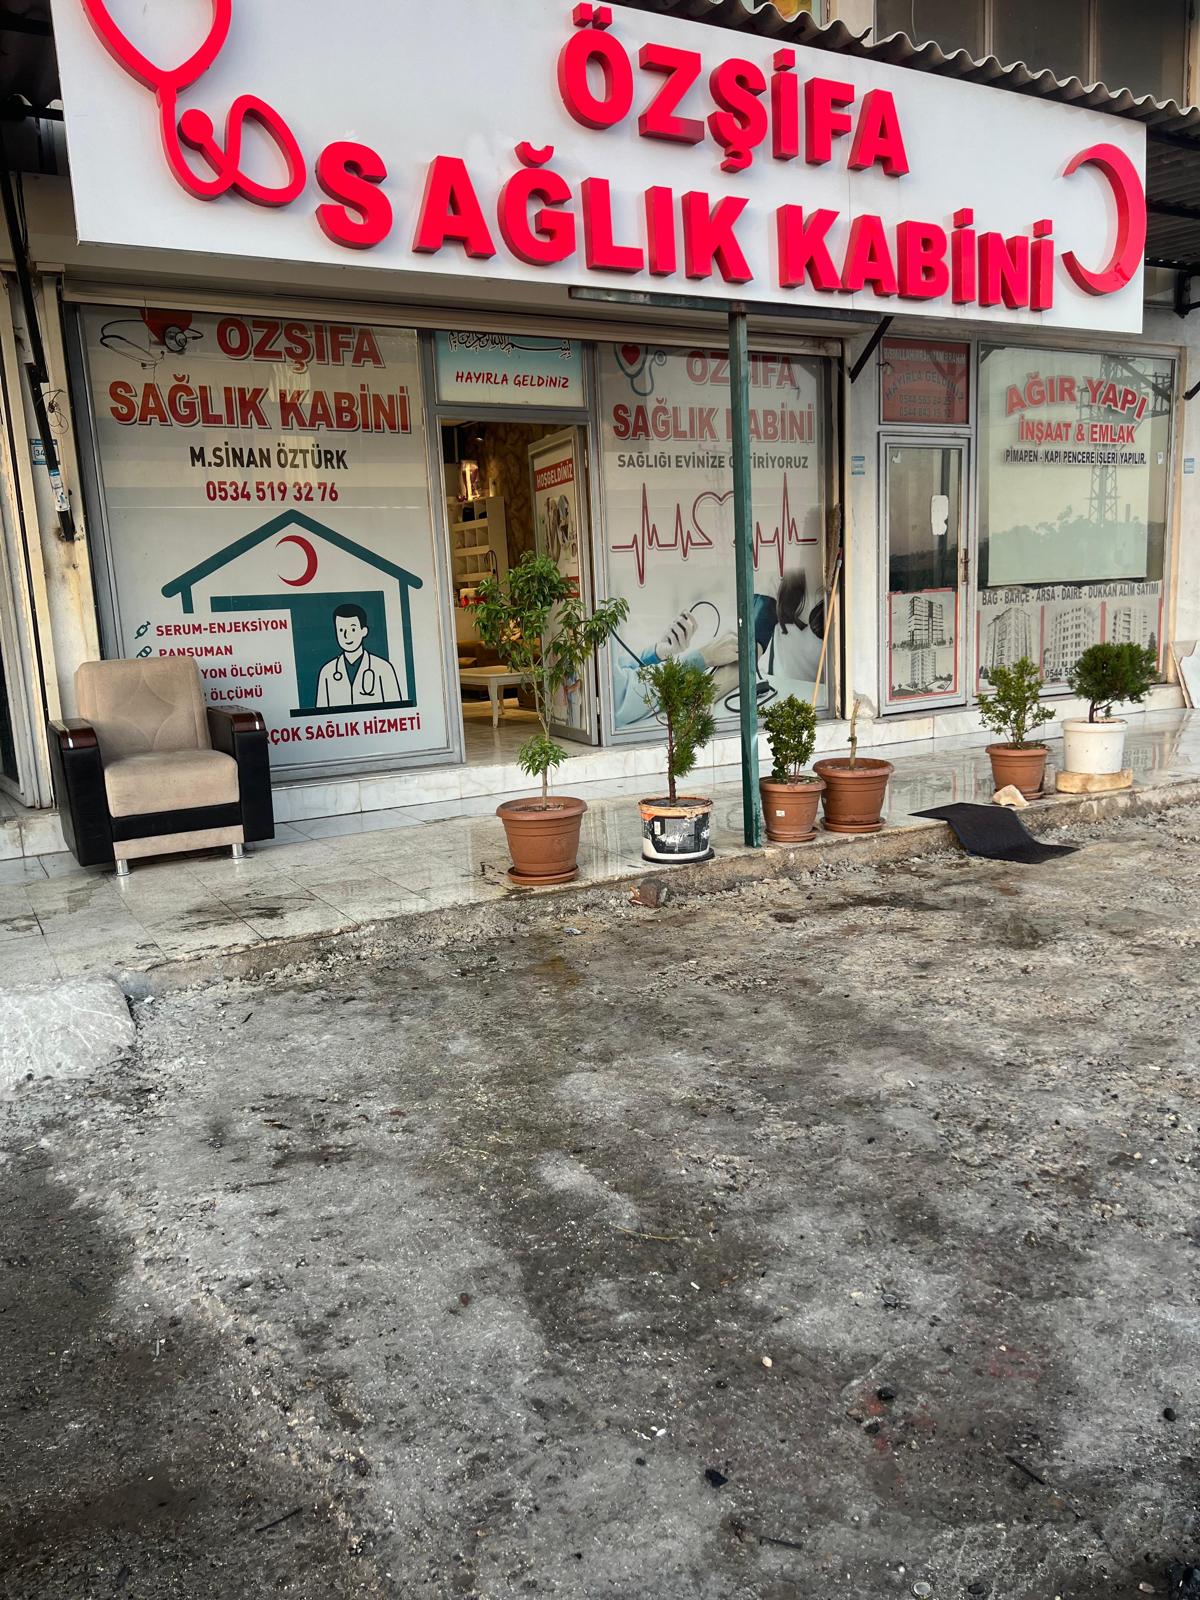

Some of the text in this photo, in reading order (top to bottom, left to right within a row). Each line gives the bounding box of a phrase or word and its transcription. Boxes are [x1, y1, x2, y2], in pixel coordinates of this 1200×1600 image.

[557, 3, 909, 177] ÖZŞİFA
[315, 141, 1054, 312] SAĞLIK KABİNİ
[455, 370, 569, 389] HAYIRLA GELDİNİZ
[108, 374, 411, 434] SAĞLIK KABİNİ
[1006, 371, 1148, 421] AĞIR YAPI
[613, 396, 719, 442] SAĞLIK
[1019, 412, 1135, 445] İNŞAAT & EMLAK
[189, 441, 348, 469] M.SİNAN ÖZTÜRK
[617, 451, 671, 468] SAĞLIĞI
[675, 451, 725, 469] EVİNİZE
[1005, 447, 1038, 463] PİMAPEN
[1044, 451, 1061, 463] KAPI
[1063, 451, 1095, 464] PENCERE
[206, 481, 338, 502] 0534 519 32 76
[1036, 590, 1056, 602] ARSA
[1118, 584, 1136, 597] ALIM
[1137, 583, 1159, 596] SATIMI
[156, 618, 288, 637] SERUM-ENJEKSİYON
[231, 662, 282, 677] ÖLÇÜMÜ
[210, 685, 263, 701] ÖLÇÜMÜ
[305, 720, 361, 741] SAĞLIK
[364, 712, 421, 735] HİZMETİ
